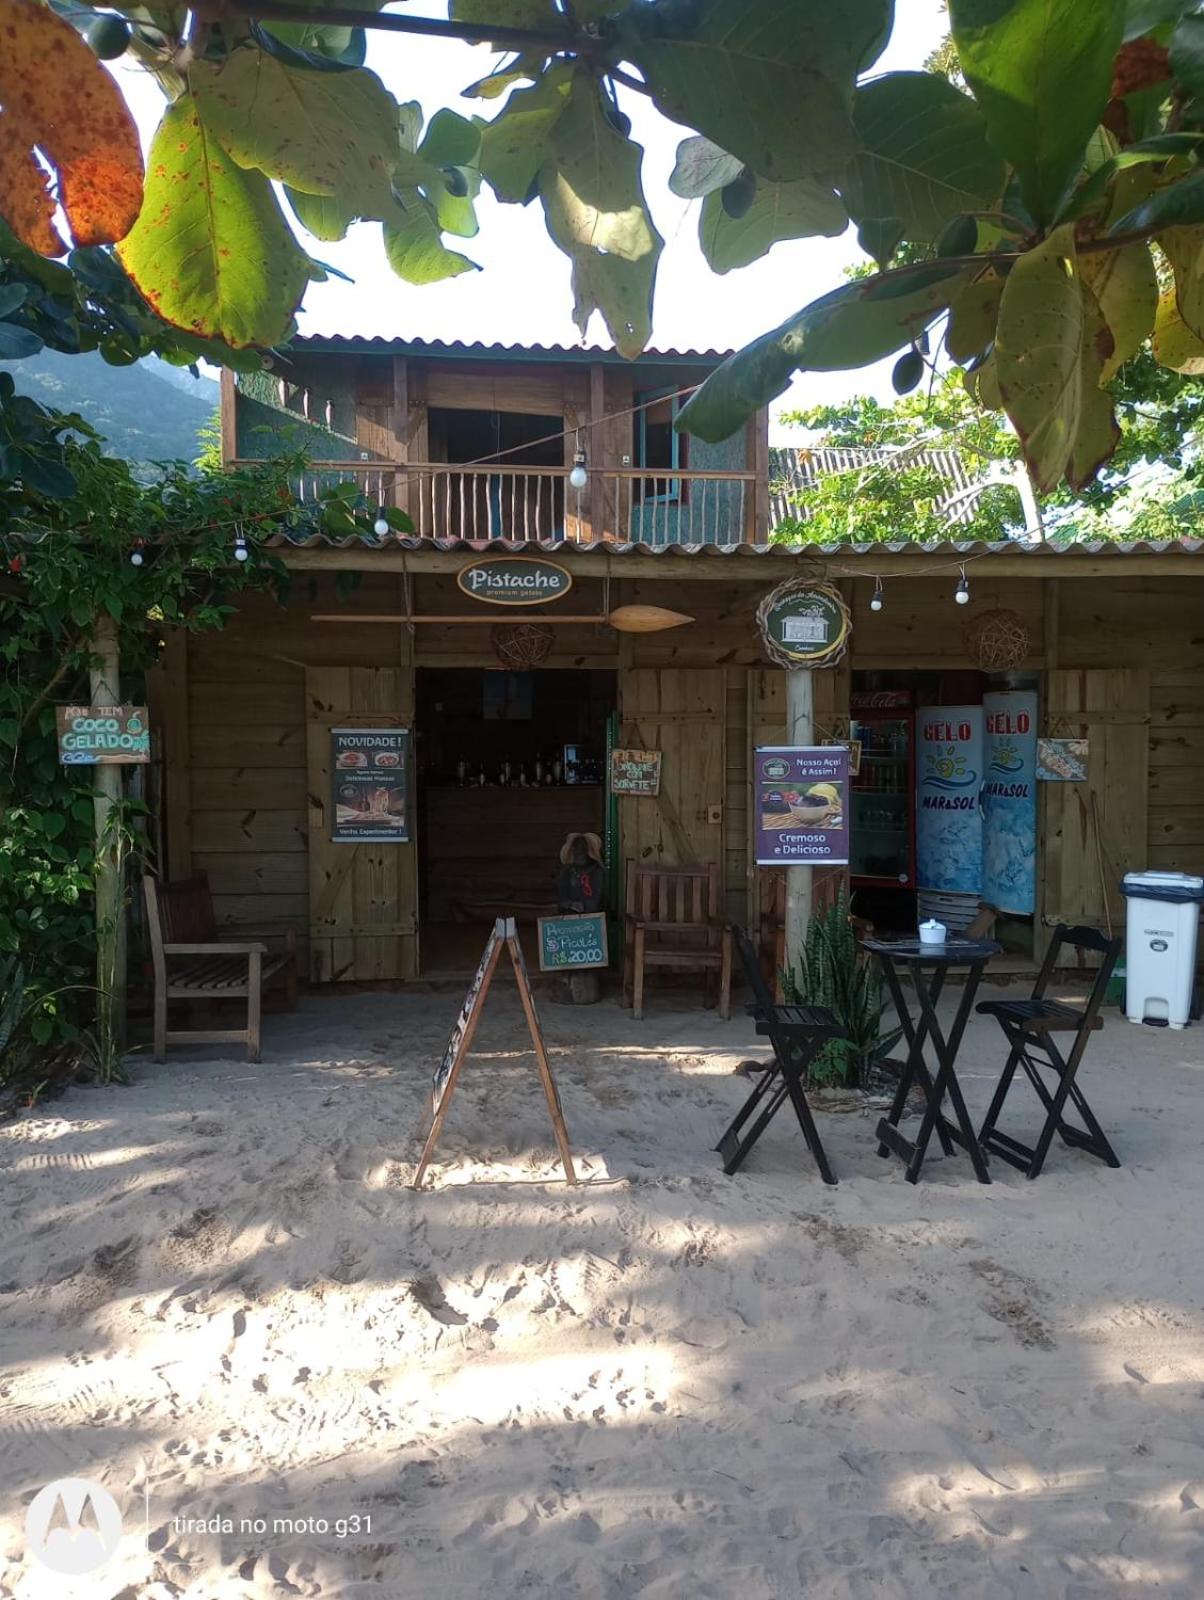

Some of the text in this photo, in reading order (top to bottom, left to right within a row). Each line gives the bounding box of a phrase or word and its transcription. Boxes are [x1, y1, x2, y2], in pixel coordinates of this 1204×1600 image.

[468, 569, 560, 590] Pistache
[72, 717, 119, 732] COCO
[985, 709, 1030, 734] GELO
[923, 720, 972, 742] GELO
[62, 732, 133, 751] GELADO
[796, 759, 822, 767] Nosso
[779, 833, 826, 842] Cremoso
[774, 844, 831, 854] e Delicioso
